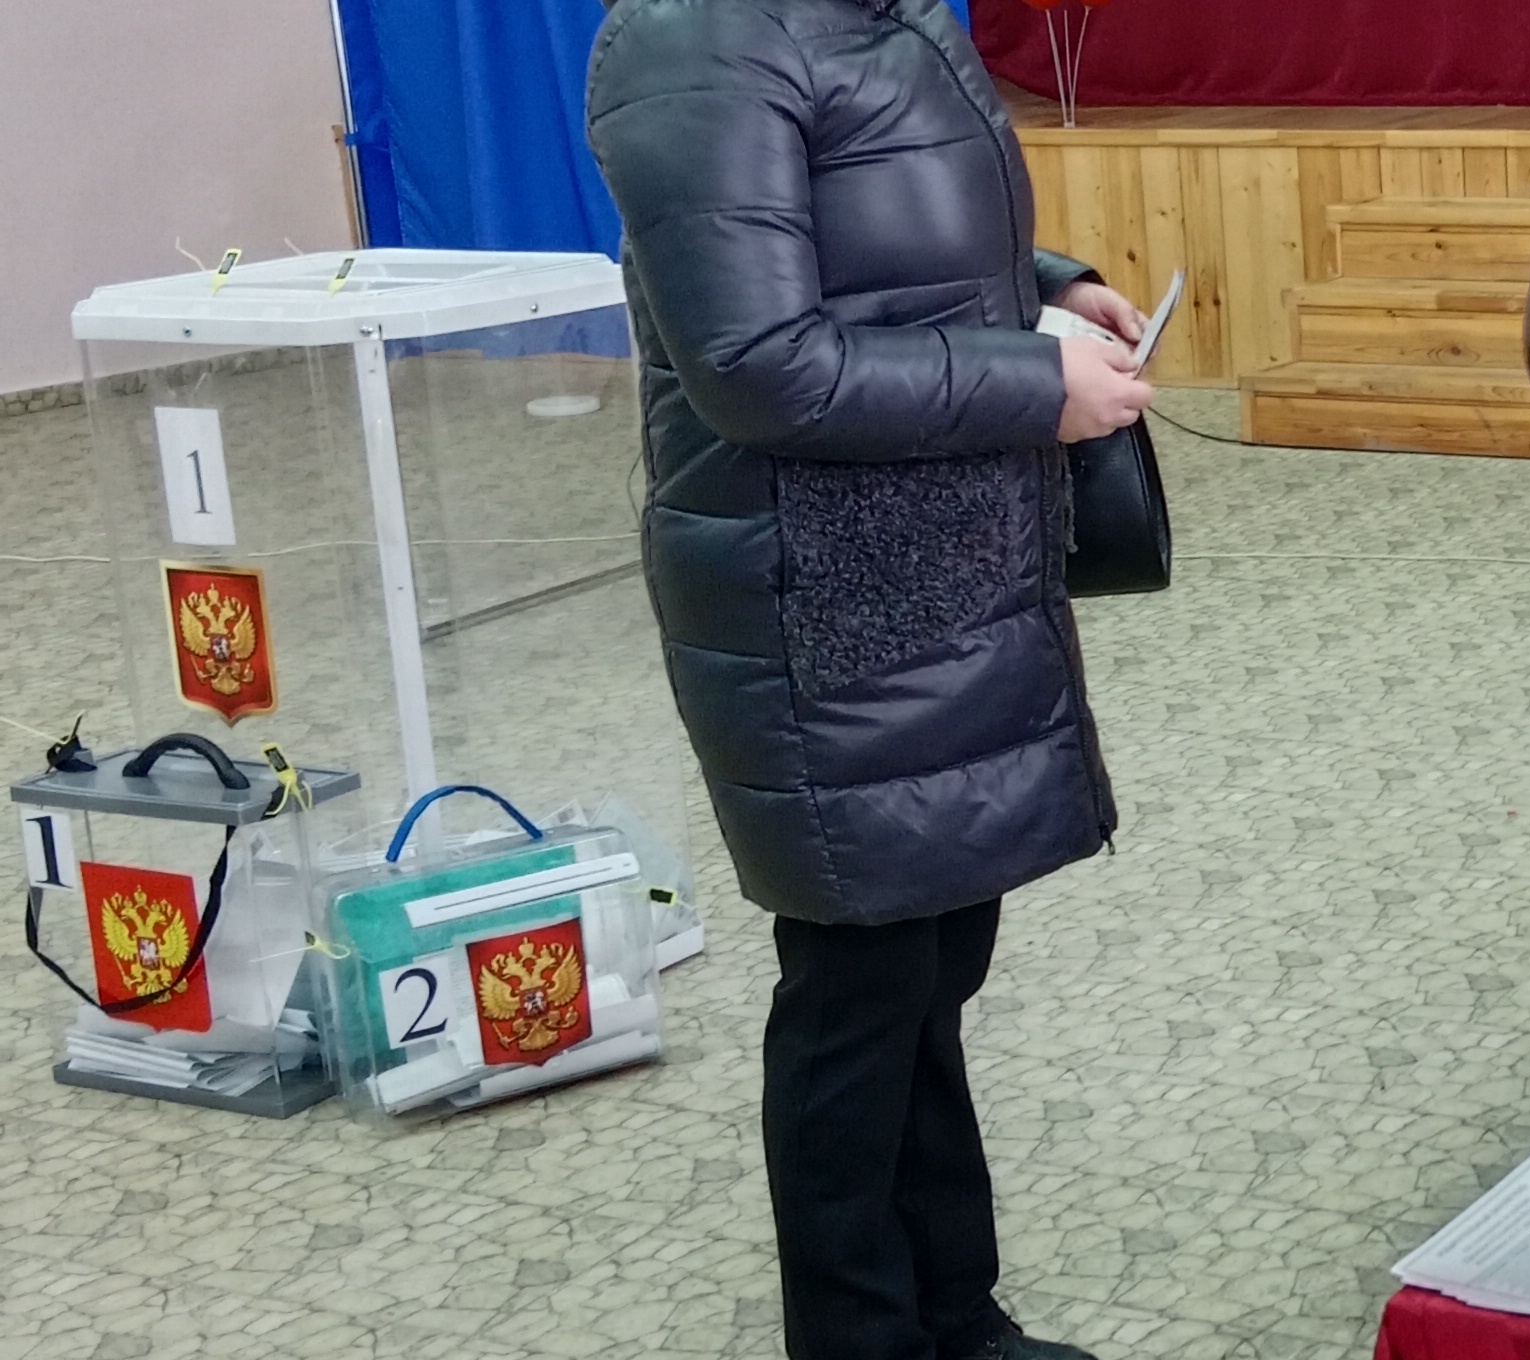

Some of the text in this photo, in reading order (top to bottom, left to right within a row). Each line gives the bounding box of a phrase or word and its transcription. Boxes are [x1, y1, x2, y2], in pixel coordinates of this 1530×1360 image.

[186, 449, 213, 515] 1
[25, 815, 73, 889] 1
[393, 967, 448, 1043] 2
